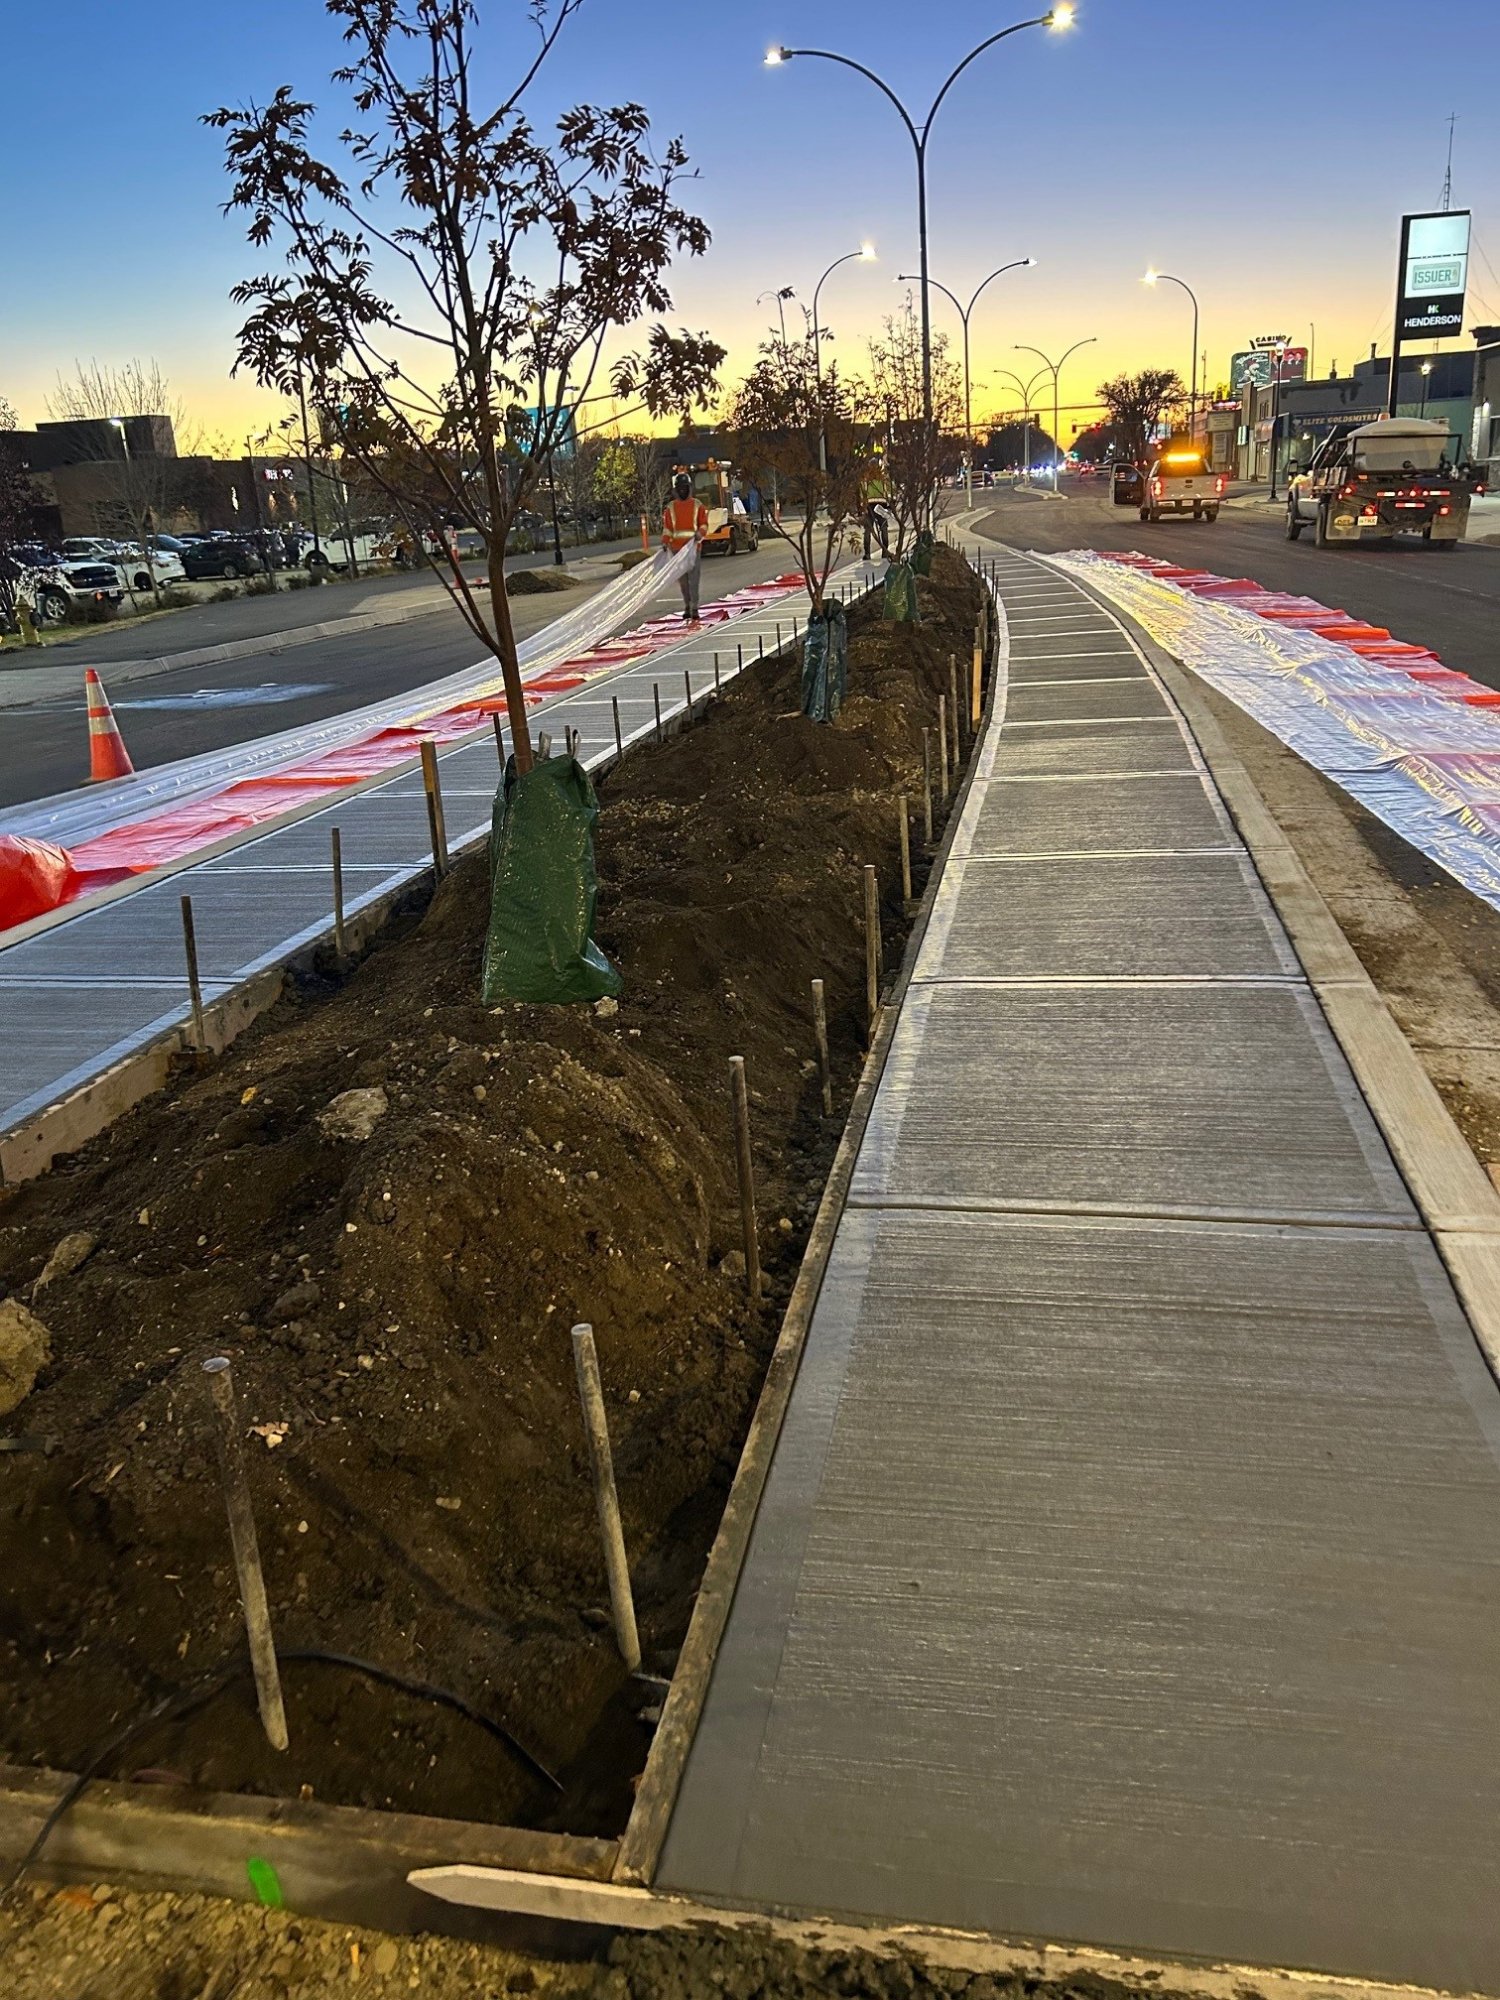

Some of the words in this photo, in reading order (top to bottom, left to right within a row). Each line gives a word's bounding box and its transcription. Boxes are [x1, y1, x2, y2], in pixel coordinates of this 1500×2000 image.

[1414, 269, 1452, 284] ISSUER
[1404, 315, 1462, 327] HENDERSON
[1255, 335, 1287, 343] CASINO
[1302, 417, 1326, 425] ELITE
